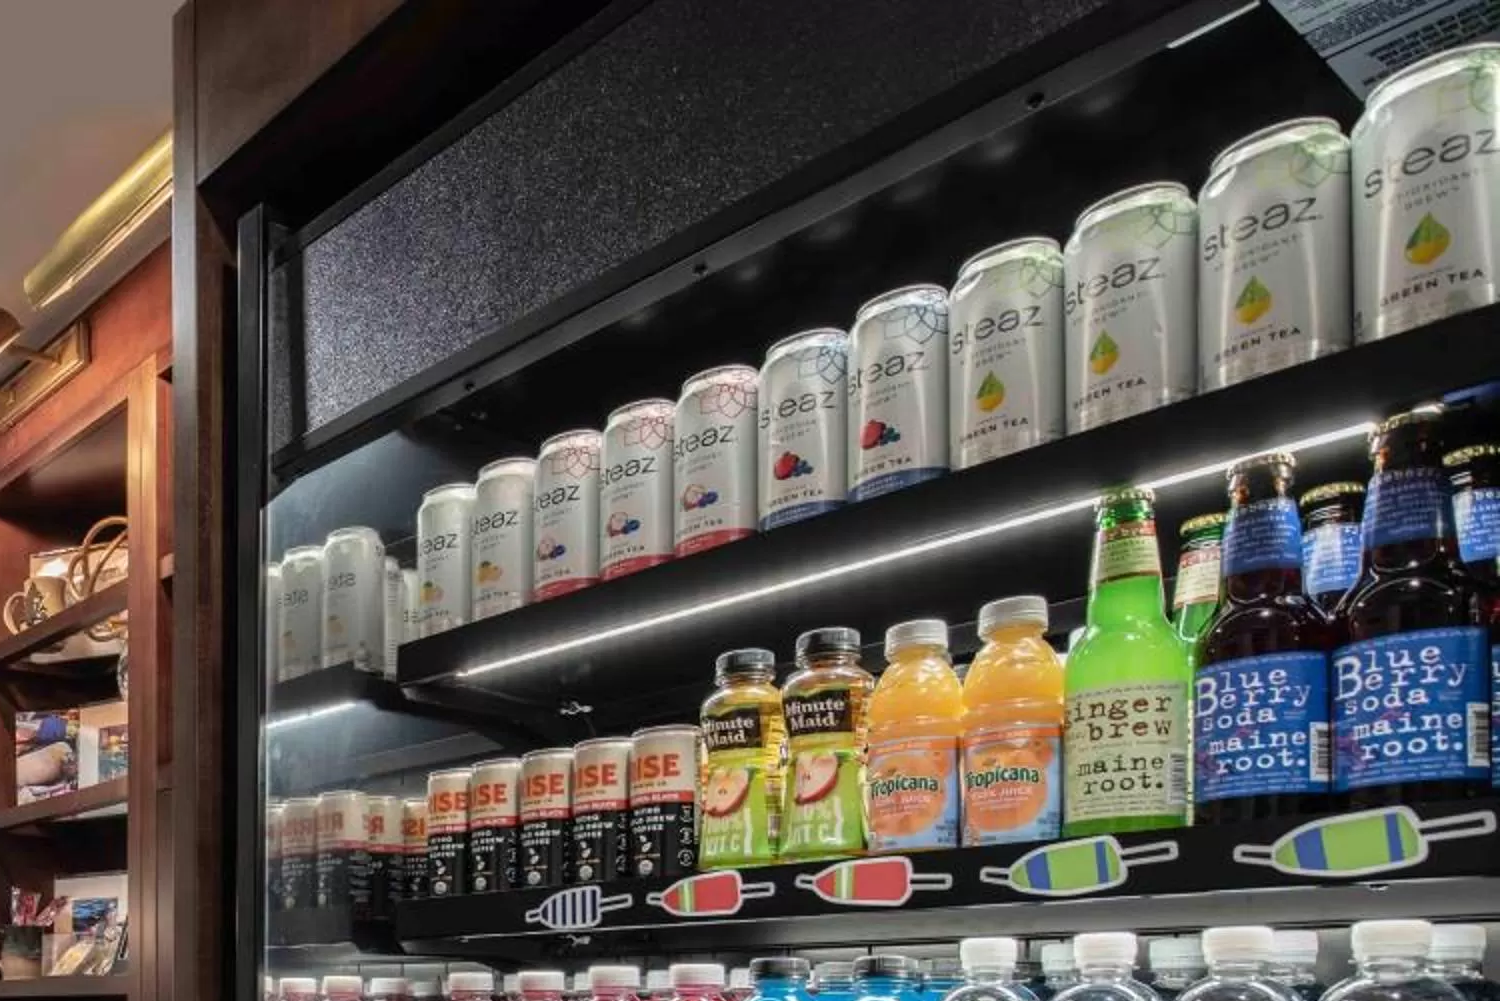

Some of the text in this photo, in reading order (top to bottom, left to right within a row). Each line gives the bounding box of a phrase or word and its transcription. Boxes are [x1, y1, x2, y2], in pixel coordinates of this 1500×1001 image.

[1448, 268, 1485, 285] TEA
[785, 698, 845, 716] Minute
[1344, 687, 1430, 715] soda
[1087, 719, 1173, 741] brew
[1202, 706, 1278, 732] soda
[1352, 712, 1464, 741] maine
[1207, 729, 1307, 755] maine
[1360, 732, 1464, 761] root.
[1076, 754, 1164, 777] maine
[1216, 747, 1307, 775] root.
[870, 773, 939, 799] Tropicana
[964, 766, 1040, 791] Tropicana
[1083, 771, 1164, 795] root.
